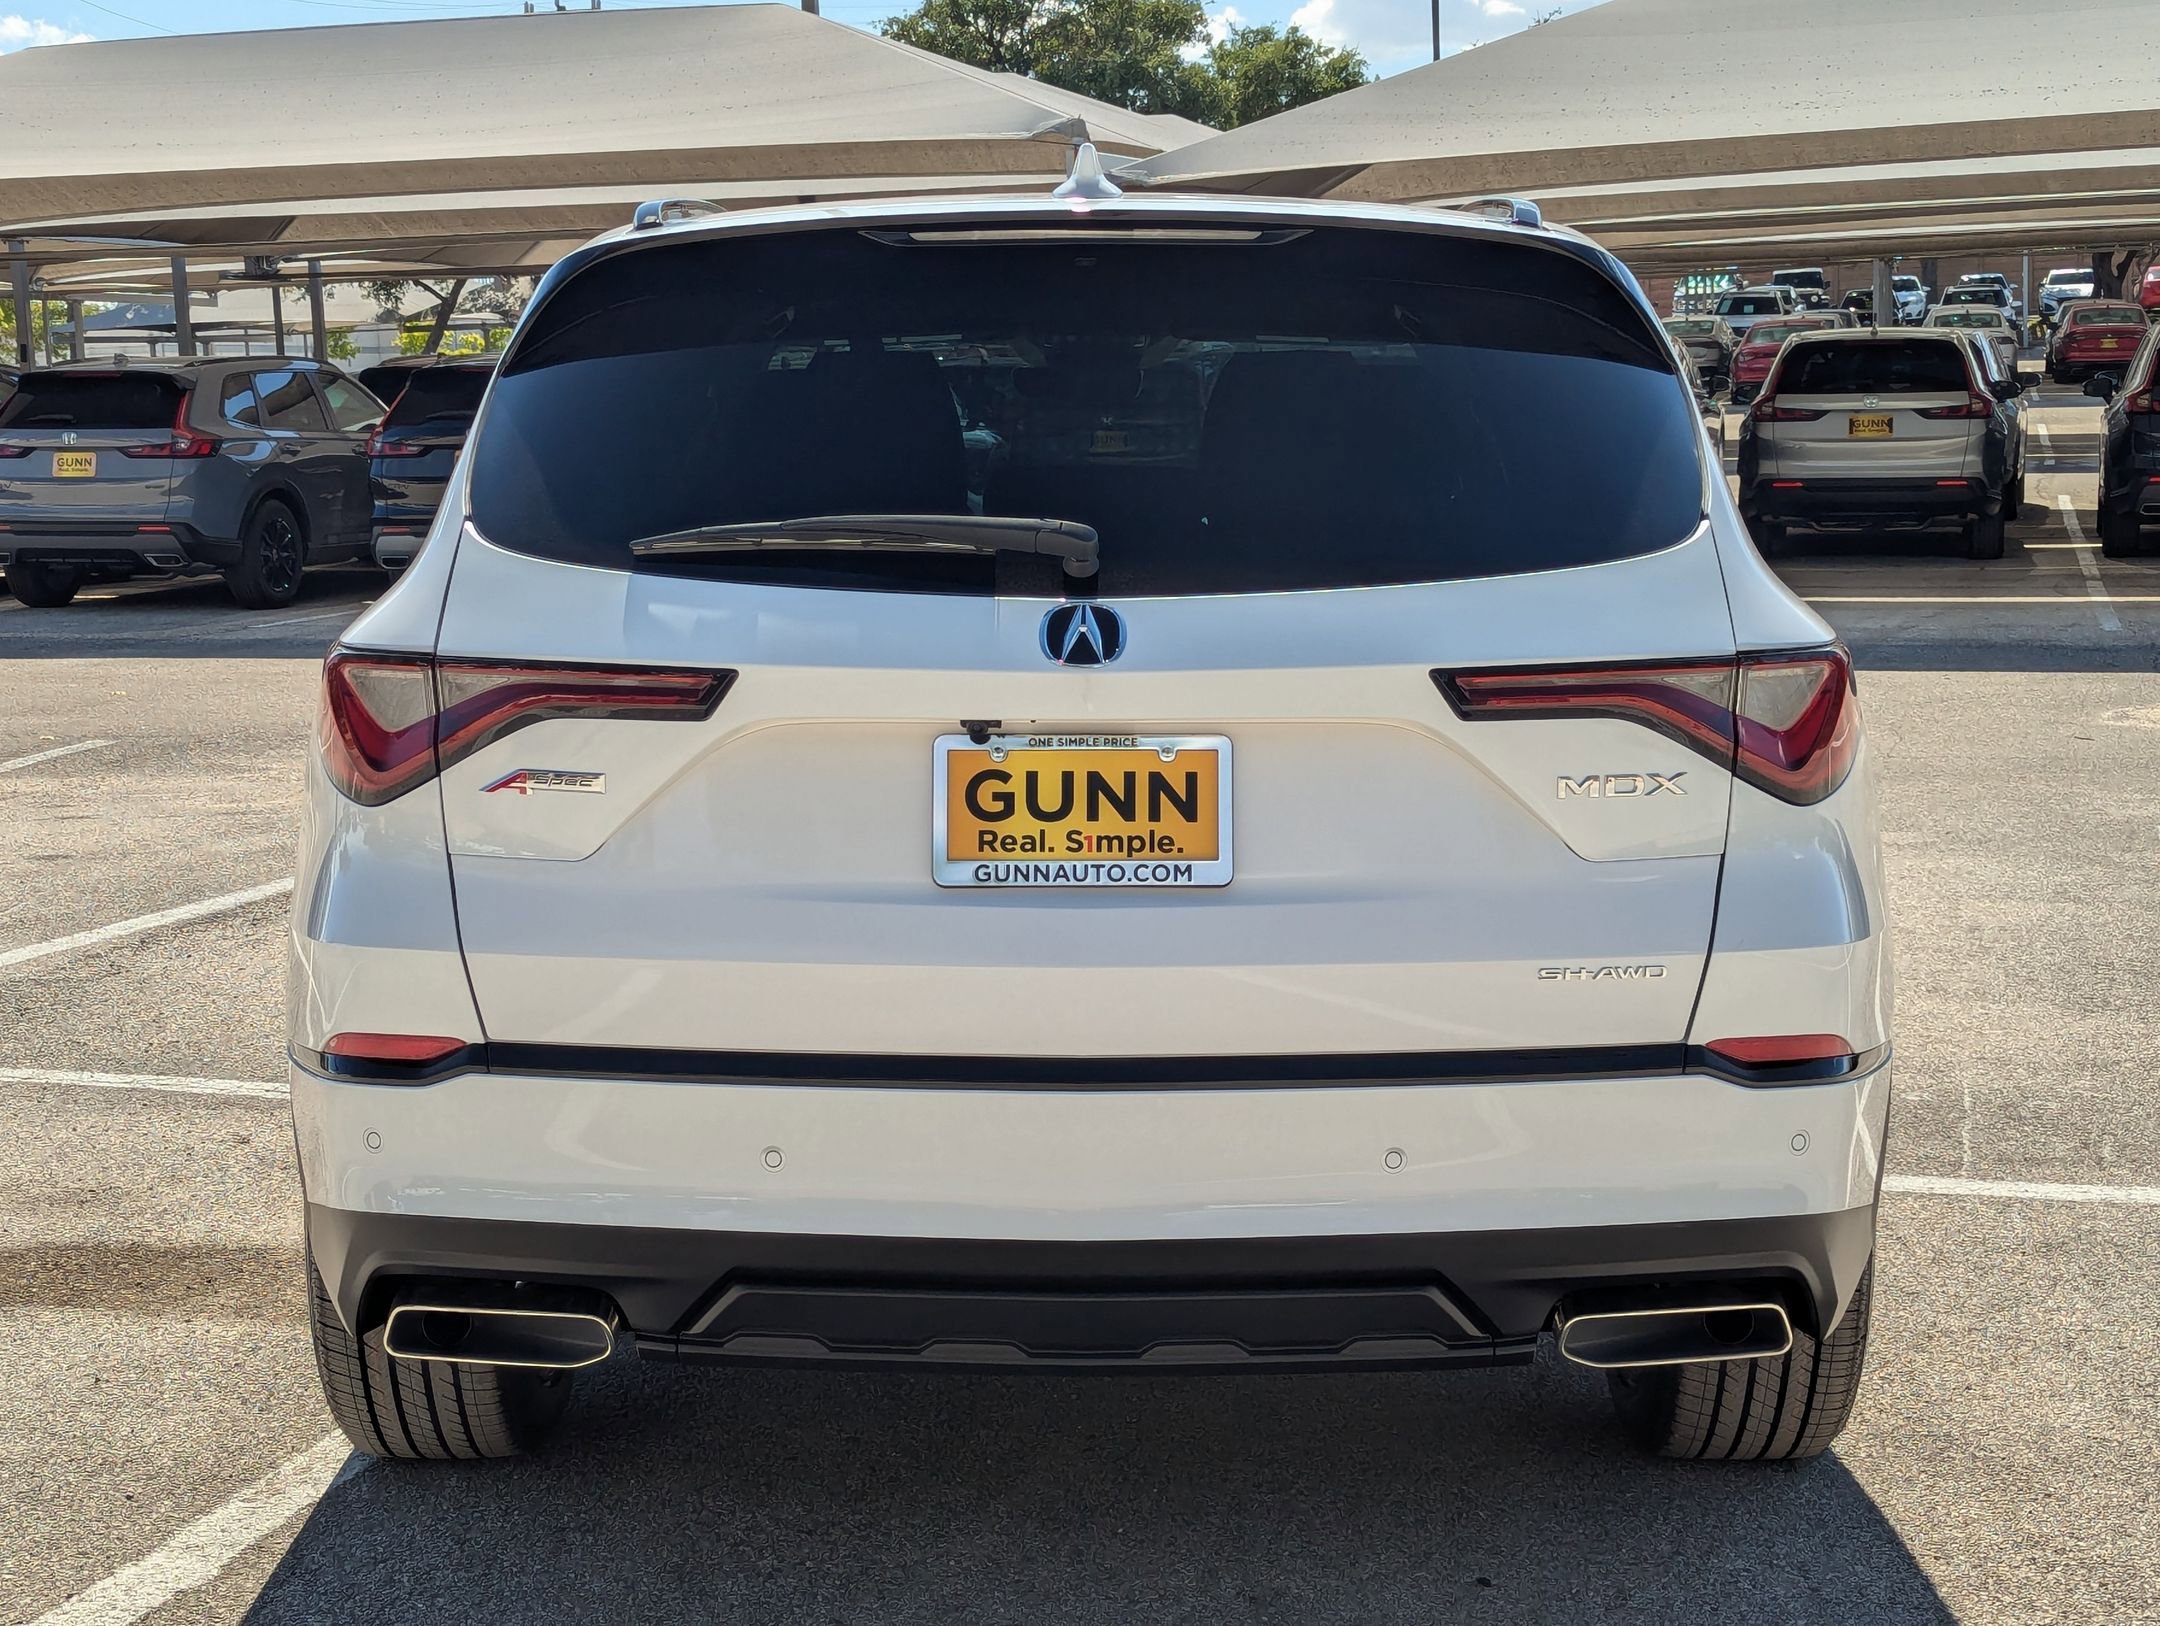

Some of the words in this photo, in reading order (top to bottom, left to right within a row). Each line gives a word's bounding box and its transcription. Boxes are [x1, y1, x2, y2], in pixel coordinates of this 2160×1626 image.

[1853, 419, 1889, 428] GUNN
[57, 457, 92, 467] GUNN
[1028, 737, 1053, 747] ONE
[1057, 737, 1099, 747] SIMPLE
[1104, 737, 1138, 747] PRICE
[1556, 772, 1687, 799] MDX
[964, 769, 1198, 822] GUNN
[978, 830, 1054, 853] Real.
[974, 863, 1192, 883] GUNNAUTO.COM
[1538, 965, 1667, 981] SH-AWD
